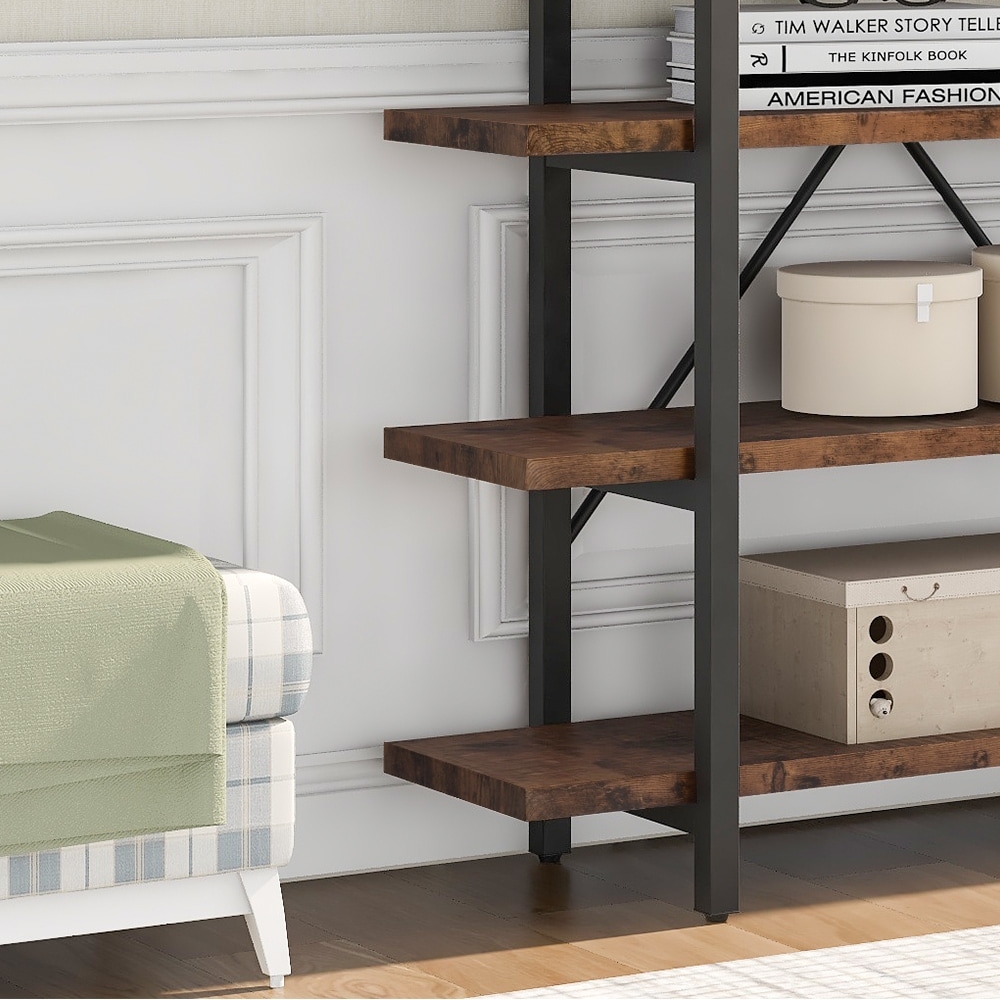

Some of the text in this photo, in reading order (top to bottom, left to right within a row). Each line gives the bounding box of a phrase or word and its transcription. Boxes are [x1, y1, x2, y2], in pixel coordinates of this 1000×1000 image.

[775, 20, 806, 35] TIM
[812, 18, 888, 34] WALKER
[894, 18, 953, 34] STORY
[828, 50, 968, 62] THE KINFOLK BOOK
[767, 89, 893, 107] AMERICAN
